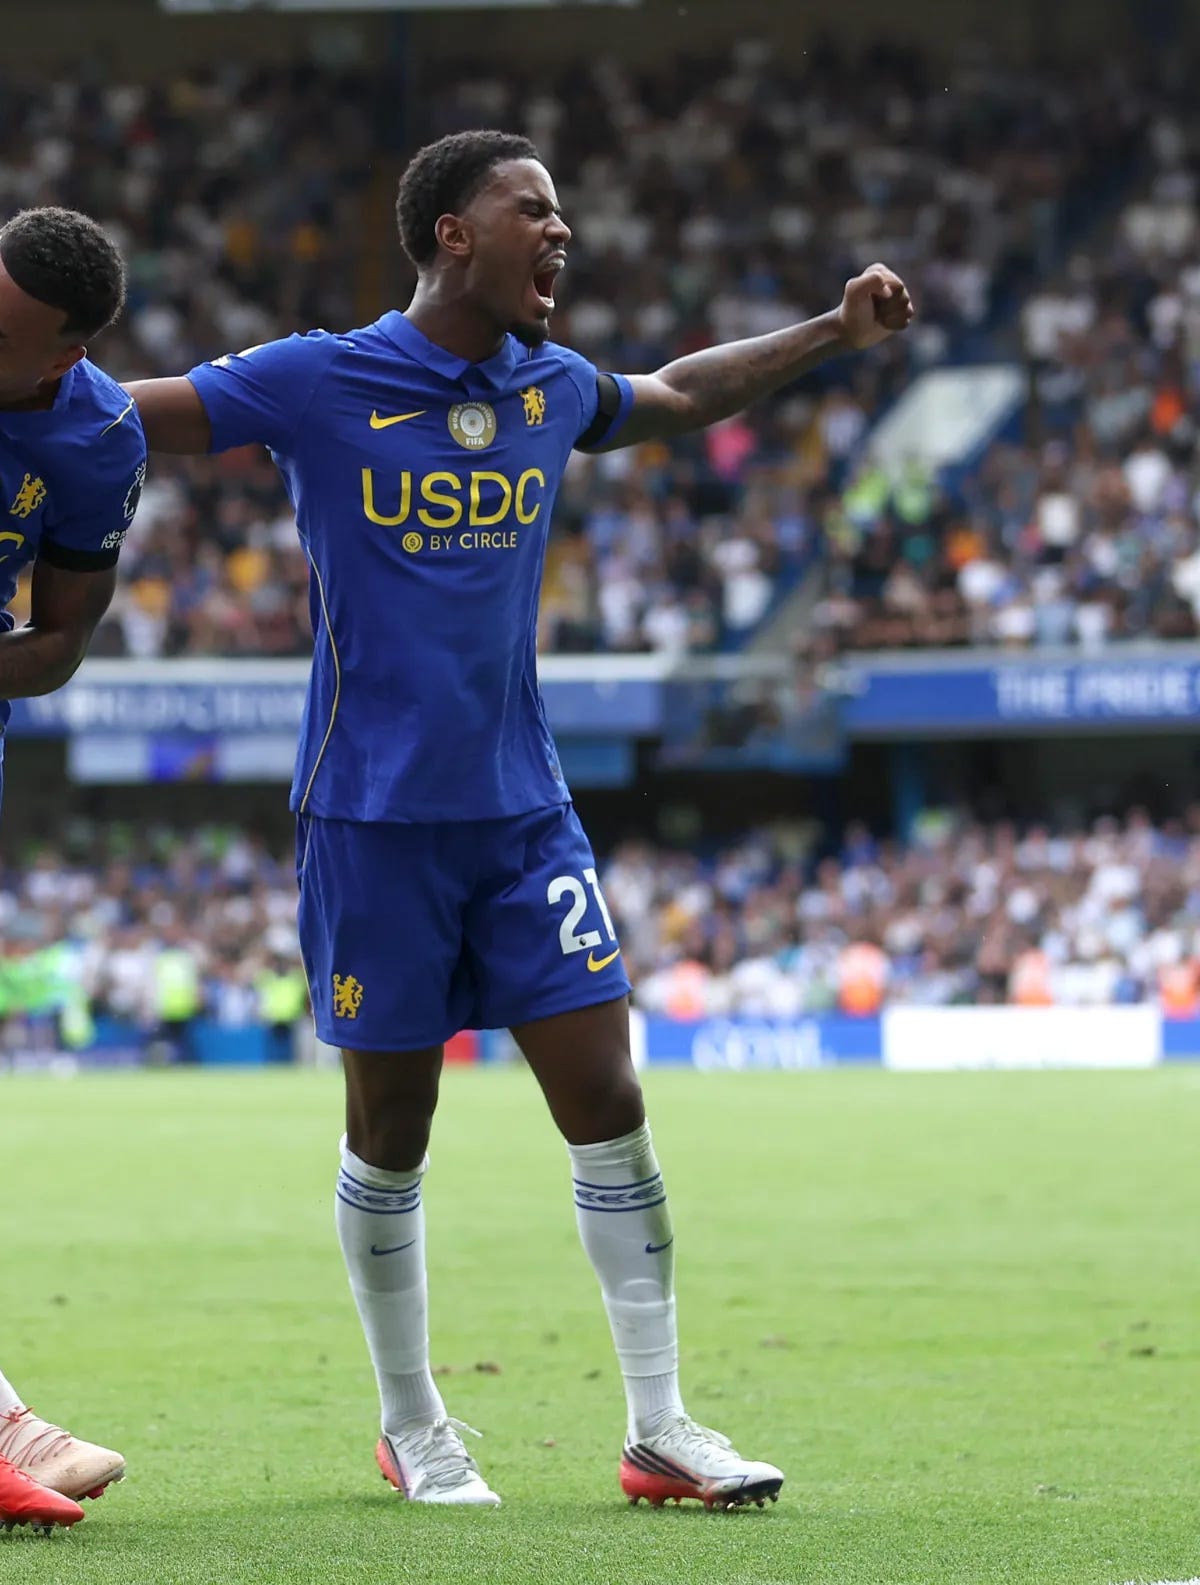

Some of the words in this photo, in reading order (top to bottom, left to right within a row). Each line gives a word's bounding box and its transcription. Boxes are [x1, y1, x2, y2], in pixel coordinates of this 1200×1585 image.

[465, 437, 485, 446] FIFA
[361, 467, 545, 529] USDC
[430, 534, 453, 551] BY
[459, 531, 518, 549] CIRCLE
[547, 867, 616, 955] 21
